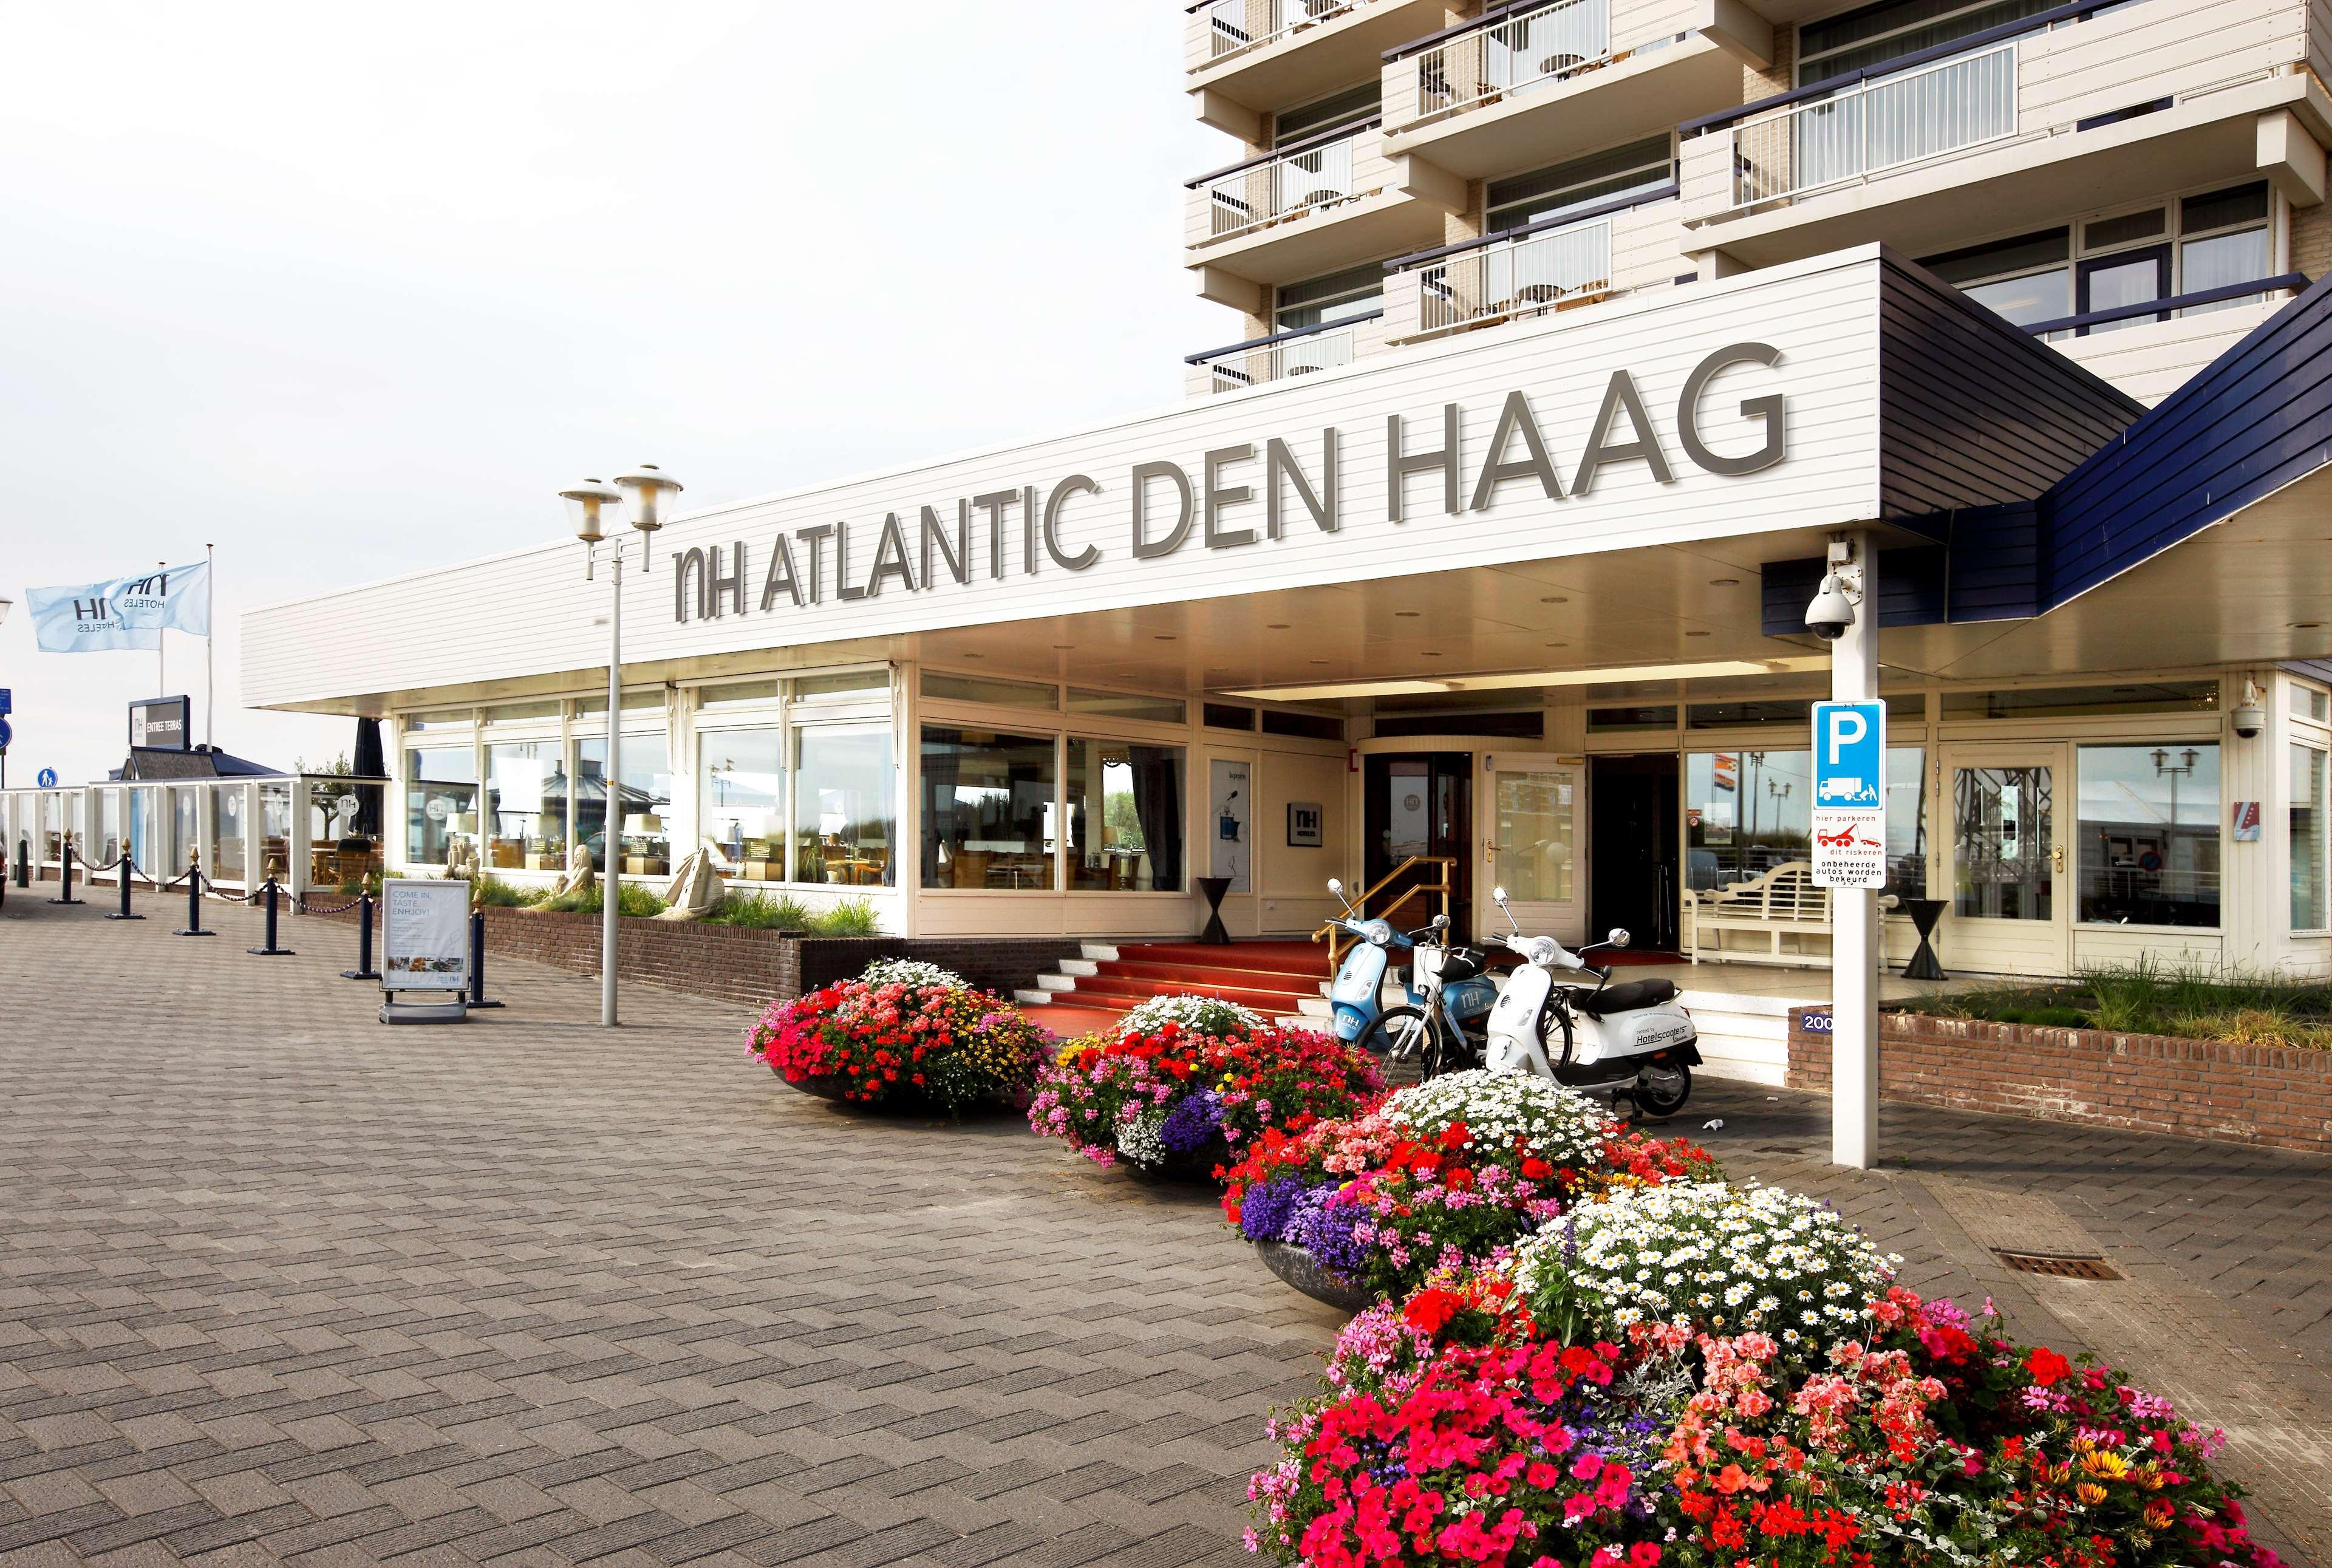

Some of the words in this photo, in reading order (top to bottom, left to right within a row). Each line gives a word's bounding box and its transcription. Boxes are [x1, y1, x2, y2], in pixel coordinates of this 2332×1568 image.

[760, 474, 1102, 612] ATLANTIC
[1132, 427, 1339, 558] DEN
[1387, 343, 1787, 522] HAAG
[147, 721, 164, 733] ENTREE
[165, 719, 182, 731] TERRAS
[1829, 711, 1867, 765] P
[393, 890, 418, 899] COME
[393, 899, 420, 908] TASTE,
[1635, 1026, 1687, 1045] Hotelscooters
